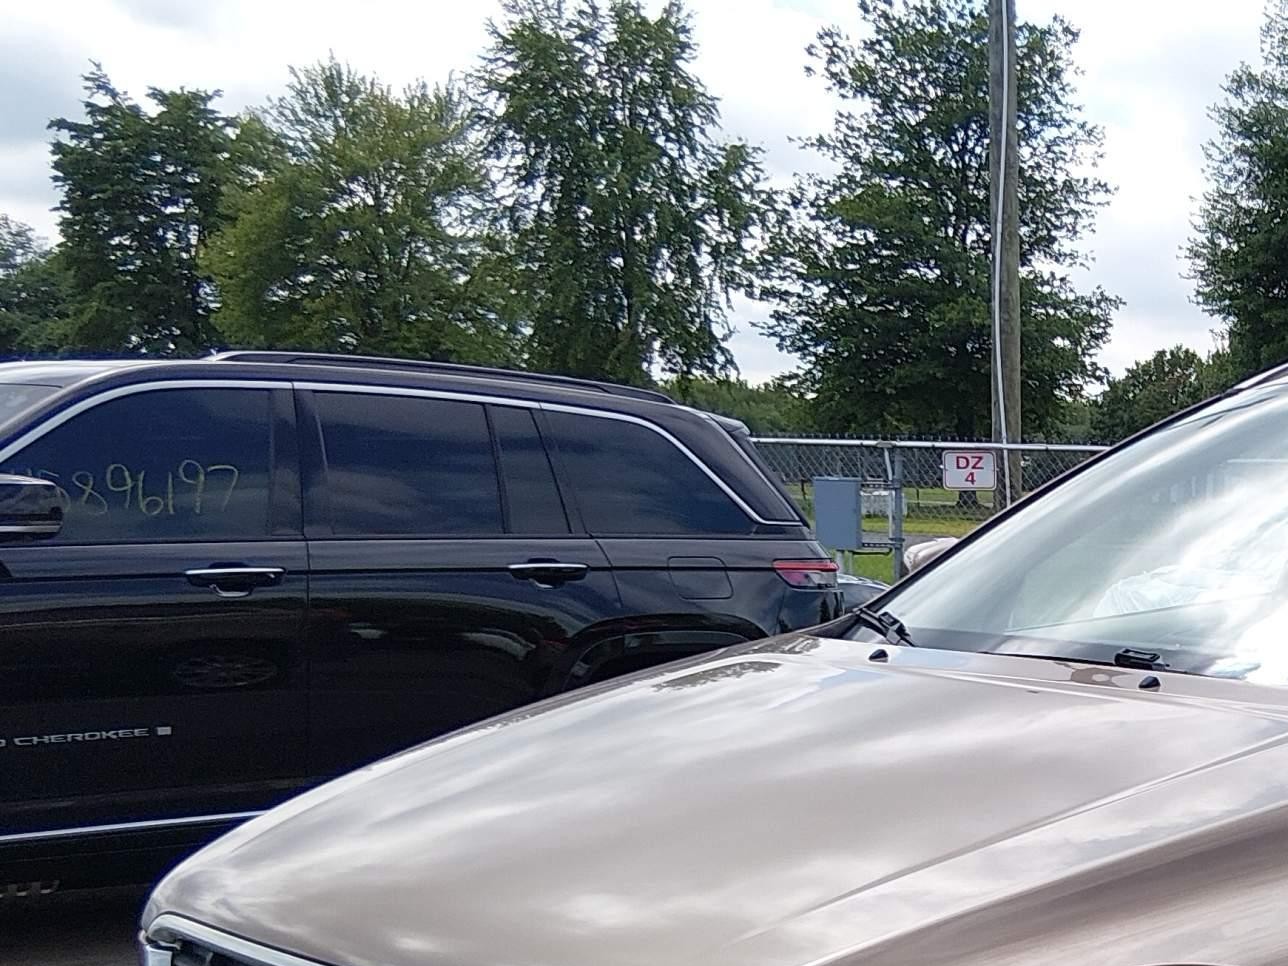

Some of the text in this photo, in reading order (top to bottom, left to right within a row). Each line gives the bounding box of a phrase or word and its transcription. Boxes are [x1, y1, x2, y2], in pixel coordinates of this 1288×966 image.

[956, 456, 984, 470] DZ
[965, 472, 976, 485] 4
[14, 728, 150, 746] CHEROKEE
